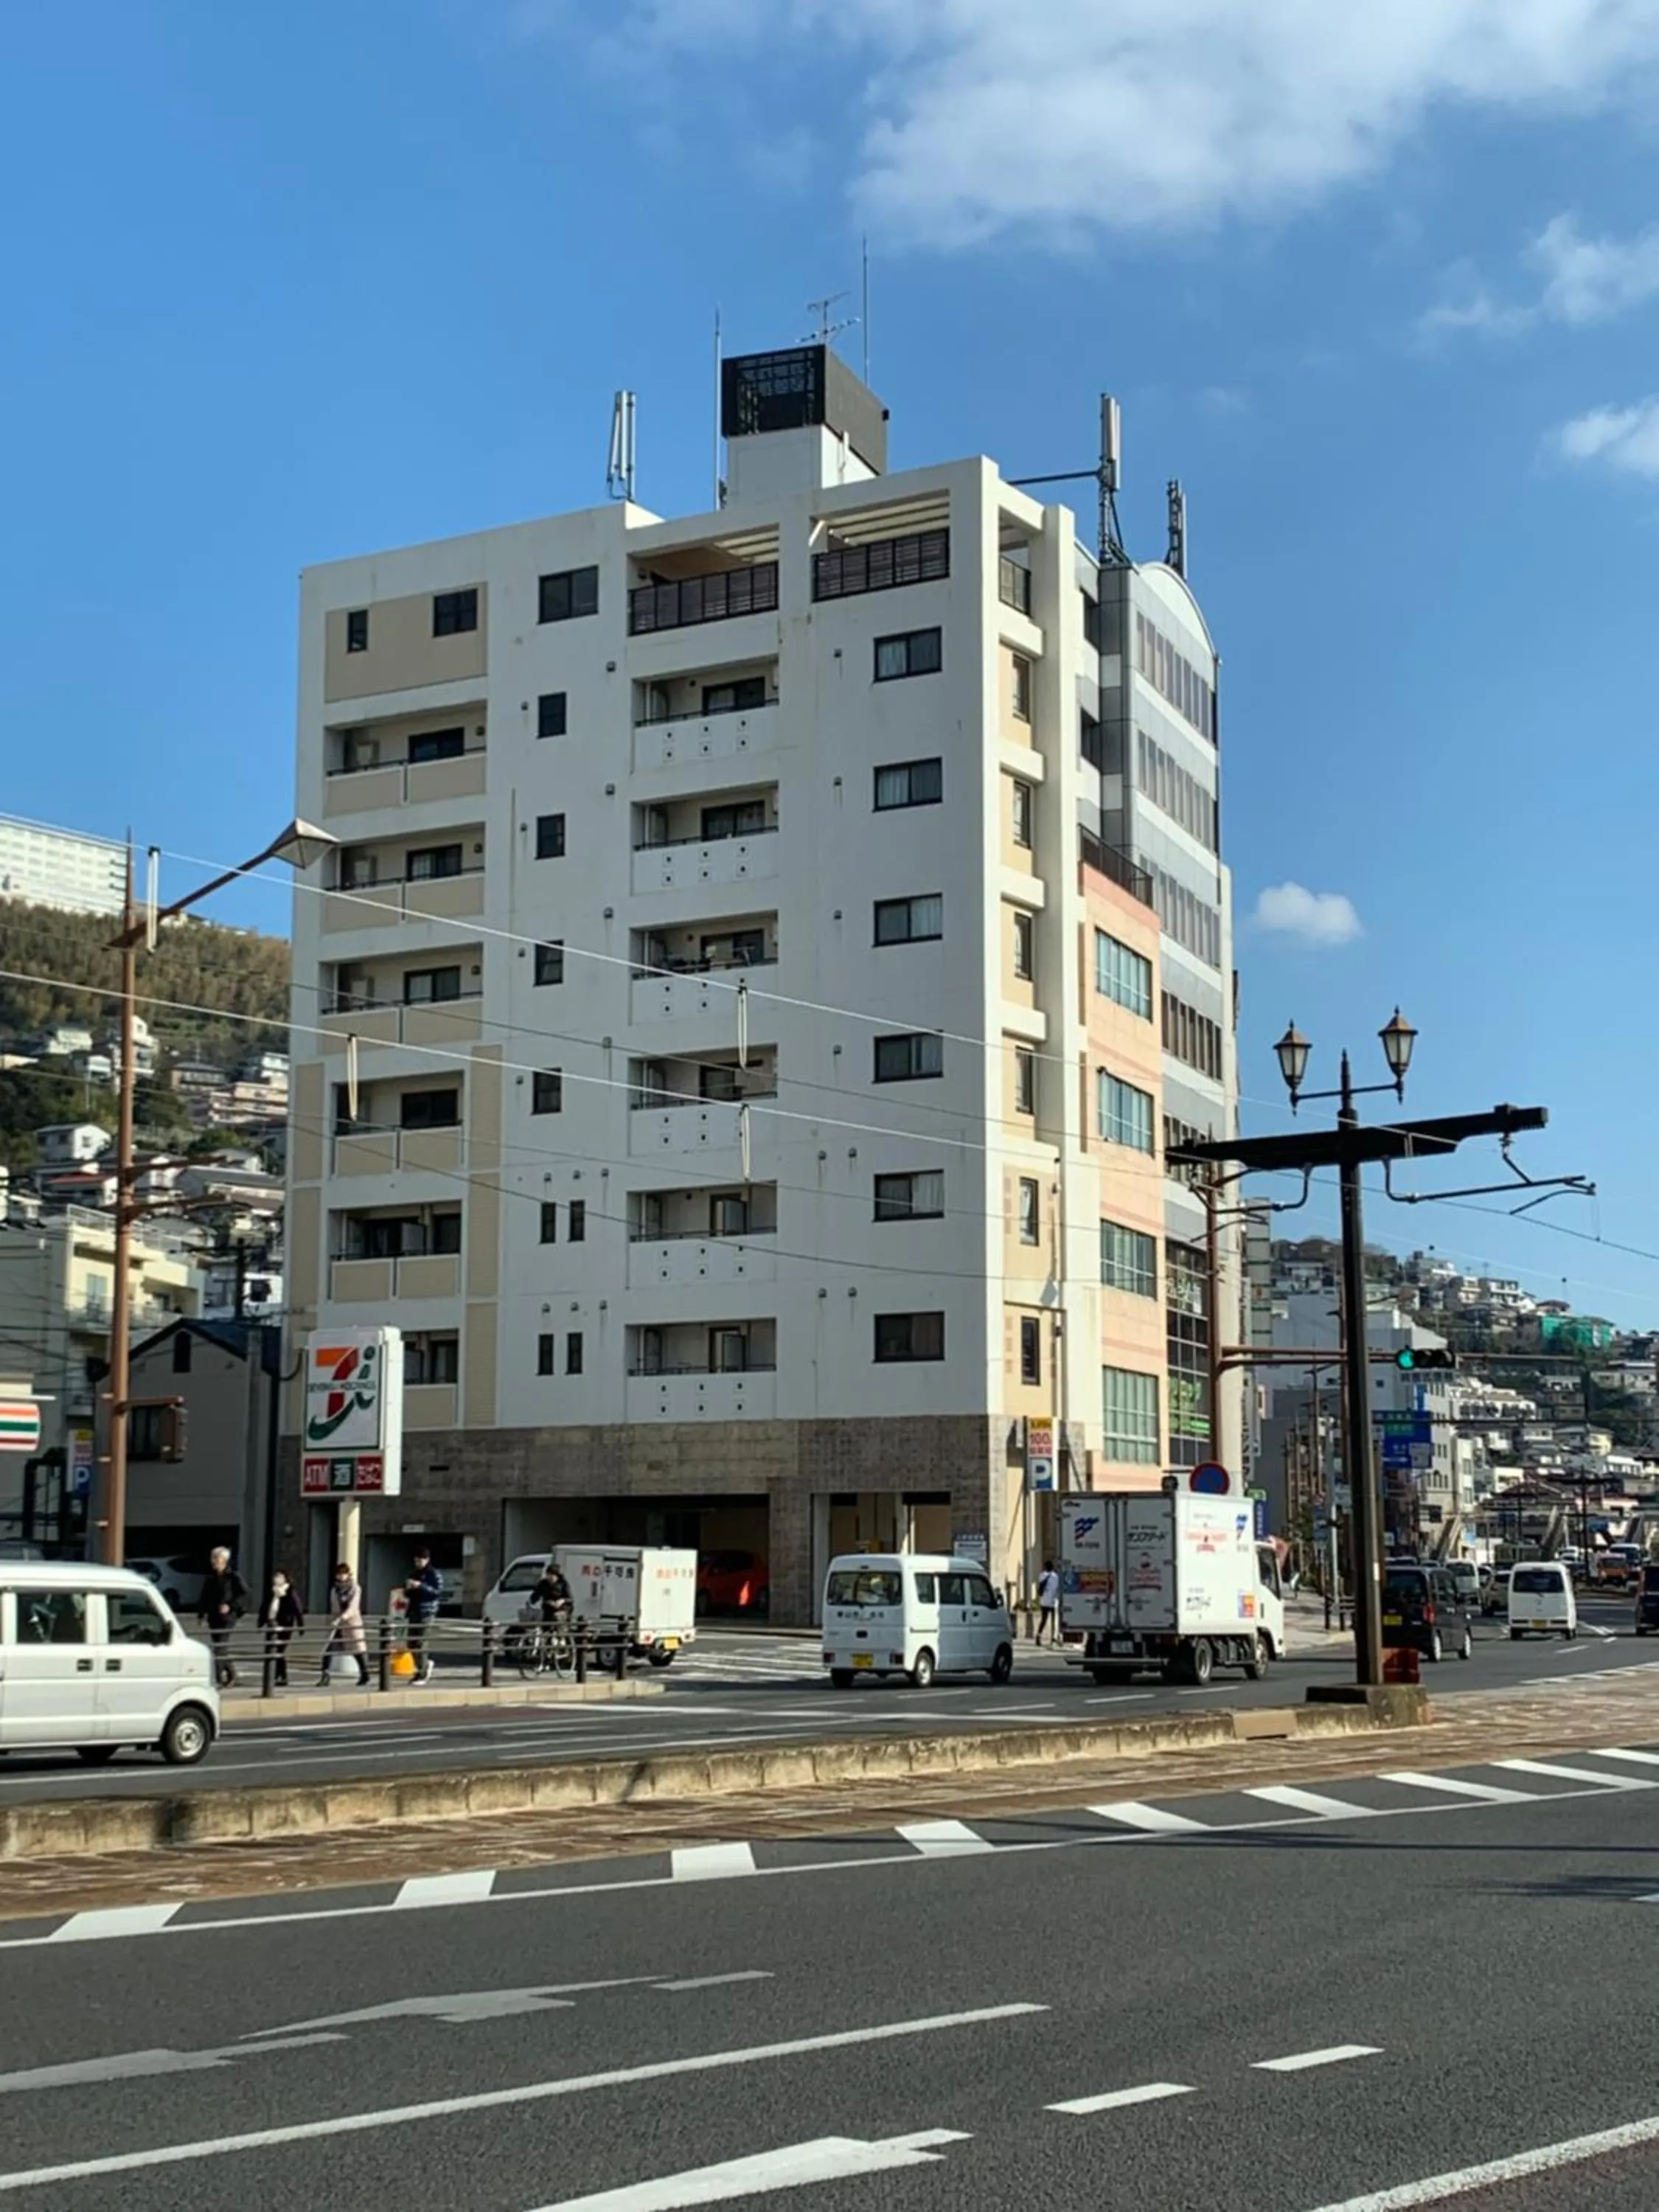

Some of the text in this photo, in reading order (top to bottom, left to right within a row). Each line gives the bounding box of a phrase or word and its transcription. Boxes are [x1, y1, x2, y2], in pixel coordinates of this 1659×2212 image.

[75, 1466, 89, 1490] P
[305, 1464, 329, 1486] ATM
[1031, 1459, 1051, 1489] P
